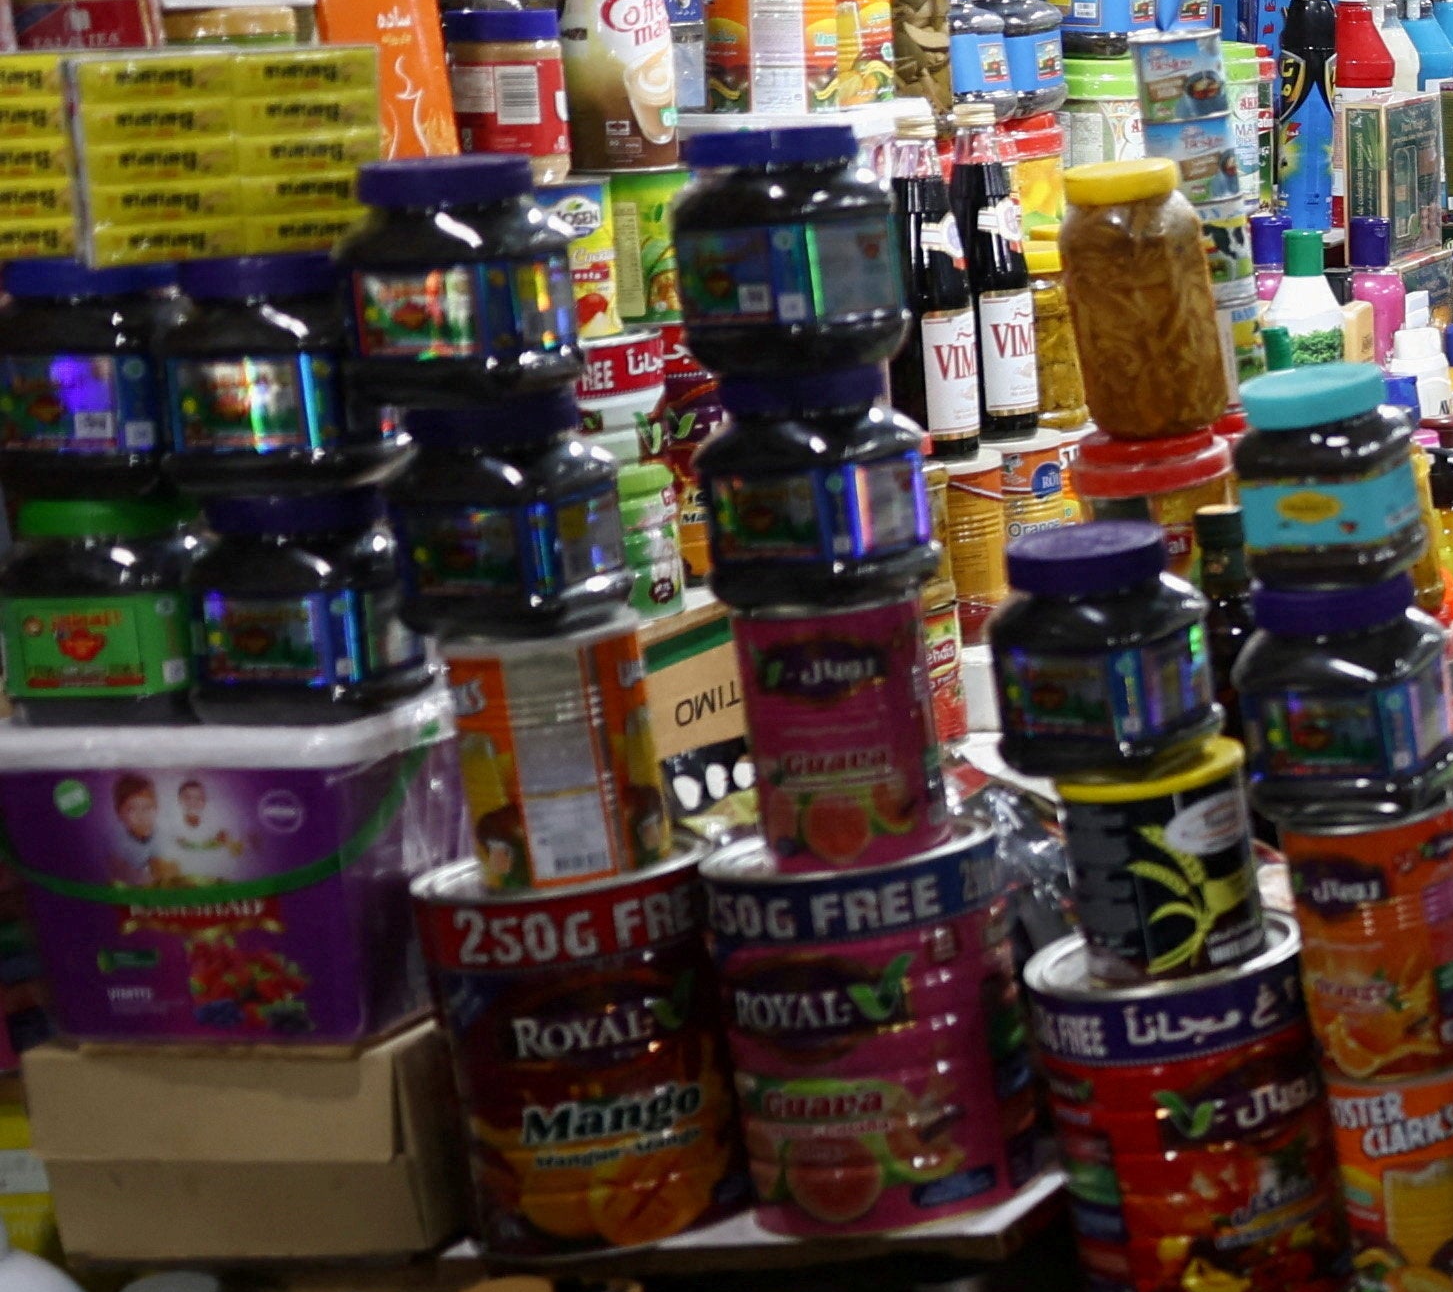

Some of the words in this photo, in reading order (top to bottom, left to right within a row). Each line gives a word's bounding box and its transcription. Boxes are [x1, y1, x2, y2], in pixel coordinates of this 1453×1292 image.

[674, 679, 742, 729] TIMO
[808, 880, 942, 937] FREE
[453, 907, 601, 965] 250G
[512, 1010, 650, 1059] ROYAL
[1123, 1005, 1241, 1045] مجاناً
[520, 1080, 700, 1146] Mango
[1327, 1094, 1403, 1130] OSTER
